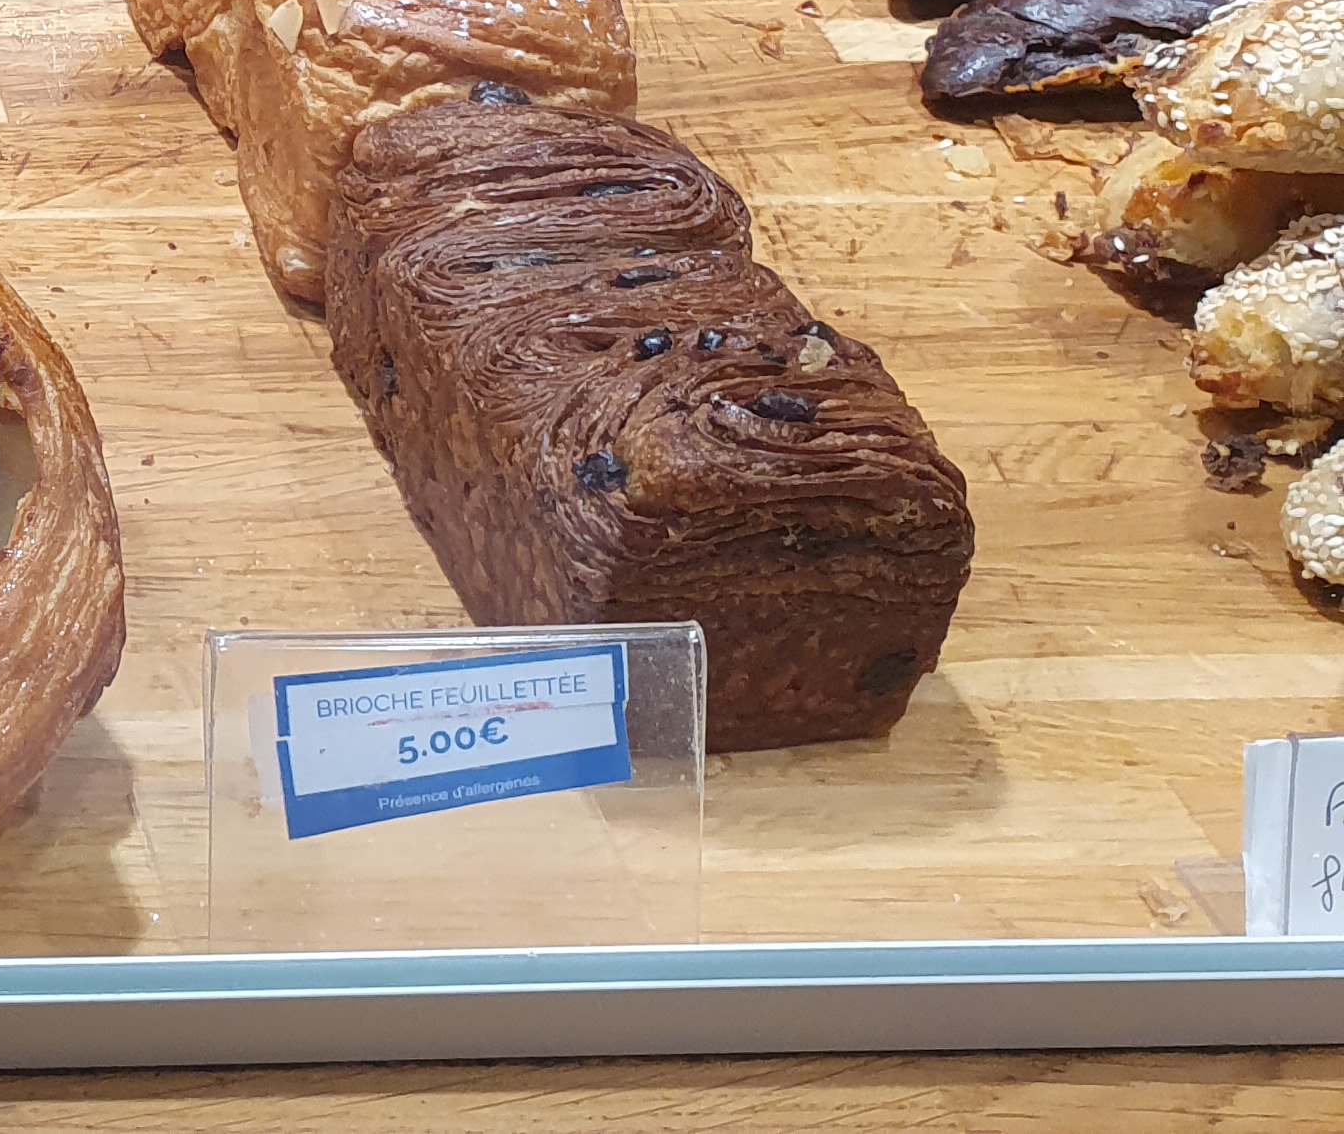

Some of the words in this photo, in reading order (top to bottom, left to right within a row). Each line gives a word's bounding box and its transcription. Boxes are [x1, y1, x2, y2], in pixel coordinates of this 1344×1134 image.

[316, 690, 424, 719] BRIOCHE
[430, 671, 588, 707] FEUILLETTÉE
[397, 716, 510, 765] 5.00€
